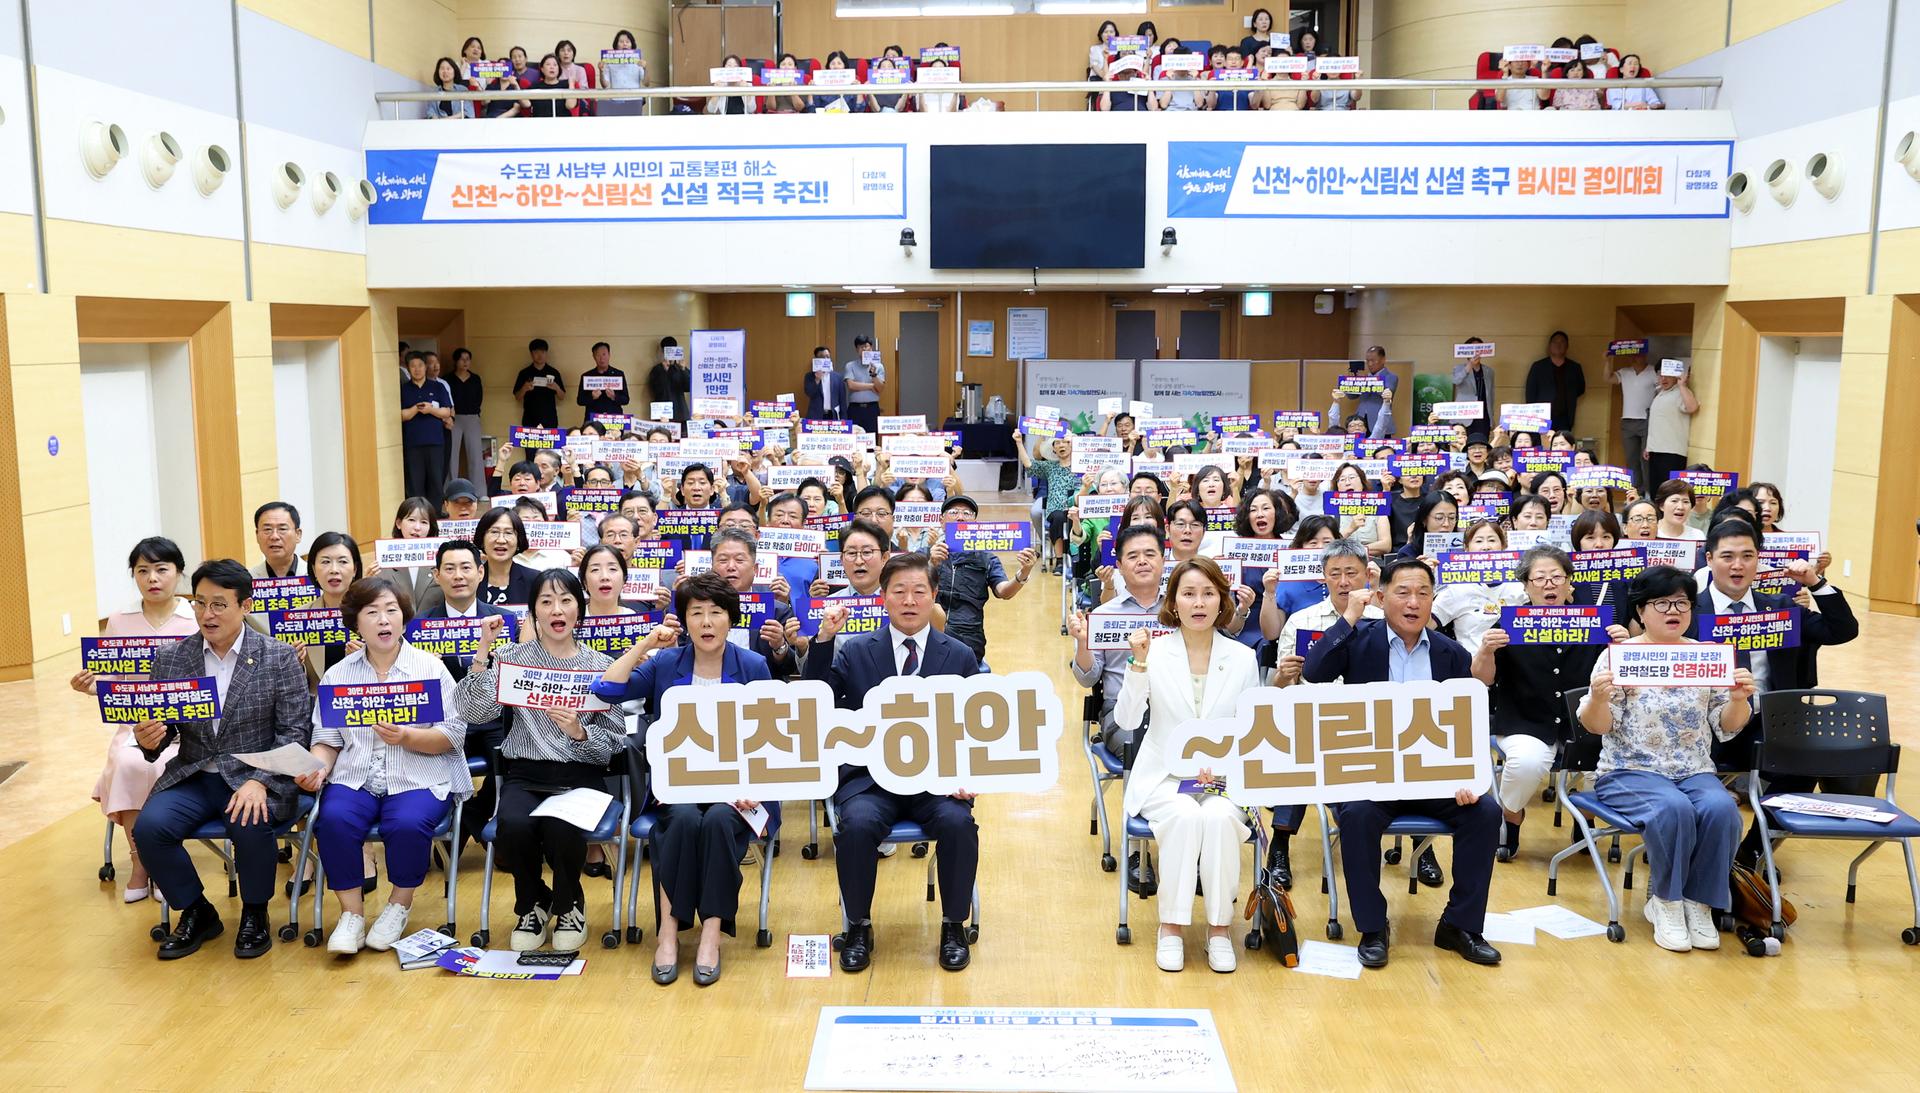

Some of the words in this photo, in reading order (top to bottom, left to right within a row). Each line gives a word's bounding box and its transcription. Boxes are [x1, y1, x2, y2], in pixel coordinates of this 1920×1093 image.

[501, 162, 551, 180] 수도권
[557, 162, 607, 180] 서남부
[613, 161, 663, 178] 시민의
[669, 161, 737, 178] 교통불편
[745, 160, 777, 177] 해소
[1686, 168, 1711, 178] 다함께
[1252, 165, 1418, 195] 신천~하안~신림선
[1426, 164, 1465, 194] 신설
[1472, 164, 1510, 194] 촉구
[1517, 164, 1577, 194] 범시민
[1584, 164, 1662, 194] 결의대회
[1686, 180, 1719, 190] 광명해요
[863, 182, 894, 192] 광명해요
[450, 183, 652, 209] 신천~하안~신림선
[662, 183, 708, 208] 신설
[718, 182, 765, 207] 적극
[774, 181, 828, 206] 추진!
[703, 372, 732, 383] 범시민
[705, 385, 729, 396] 1만명
[520, 440, 554, 450] 신설하라!
[833, 442, 854, 452] 답이다!
[605, 453, 635, 462] 신설하라!
[920, 465, 946, 475] 연결하라!
[1401, 467, 1437, 476] 반영하라!
[1526, 463, 1562, 472] 반영하라!
[566, 495, 584, 504] 수도권
[585, 496, 602, 504] 서남부
[1329, 498, 1362, 507] 국가철도망
[1363, 498, 1387, 507] 구축계획
[566, 502, 593, 512] 민자사업
[594, 503, 609, 512] 조속
[1083, 505, 1111, 515] 광역철도망
[1339, 506, 1378, 516] 반영하라!
[441, 520, 455, 529] 30만
[455, 520, 471, 529] 시민의
[533, 523, 549, 531] 시민의
[550, 523, 565, 531] 염원!
[658, 517, 678, 526] 수도권
[680, 517, 699, 526] 서남부
[658, 524, 688, 536] 민자사업
[690, 525, 706, 536] 조속
[954, 530, 1022, 540] 신천~하안~신림선
[387, 543, 406, 552] 출퇴근
[407, 542, 433, 551] 교통지옥
[963, 539, 1014, 552] 신설하라!
[381, 553, 403, 564] 철도망
[404, 552, 425, 563] 확충이
[1291, 555, 1310, 563] 출퇴근
[1453, 553, 1471, 561] 수도권
[635, 573, 650, 582] 보장!
[1442, 571, 1480, 583] 민자사업
[1483, 570, 1503, 582] 조속
[253, 588, 278, 599] 서남부
[280, 585, 316, 597] 광역철도
[288, 612, 308, 621] 수도권
[309, 611, 328, 620] 서남부
[1529, 608, 1545, 616] 30만
[1546, 608, 1565, 616] 시민의
[275, 621, 304, 632] 수도권
[306, 619, 333, 631] 서남부
[425, 619, 445, 628] 수도권
[446, 618, 465, 627] 서남부
[1103, 620, 1127, 630] 출퇴근
[1129, 619, 1160, 630] 교통지옥
[1512, 616, 1602, 629] 신천~하안~신림선
[412, 629, 441, 641] 수도권
[443, 628, 471, 640] 서남부
[1712, 621, 1793, 638] 신천~하안~신림선
[1094, 631, 1121, 643] 철도망
[1523, 629, 1589, 644] 신설하라!
[610, 638, 632, 652] 조속
[87, 648, 118, 660] 수도권
[121, 648, 151, 660] 서남부
[1622, 652, 1668, 663] 광명시민의
[1670, 651, 1698, 663] 교통권
[1701, 651, 1722, 662] 보장!
[523, 669, 543, 679] 30만
[545, 671, 571, 682] 시민의
[574, 673, 593, 683] 염원!
[1618, 665, 1669, 679] 광역철도망
[1673, 663, 1727, 680] 연결하라!
[114, 682, 135, 692] 수도권
[137, 682, 158, 692] 서남부
[160, 681, 193, 692] 교통혁명,
[103, 693, 132, 706] 수도권
[134, 692, 164, 705] 서남부
[167, 690, 213, 705] 광역철도
[332, 693, 429, 710] 신천~하안~신림선
[526, 693, 586, 709] 신설하라!
[104, 706, 150, 723] 민자사업
[153, 705, 179, 721] 조속
[182, 703, 215, 719] 추진!
[344, 708, 417, 726] 신설하라!
[663, 690, 1044, 785] 신천~하안
[1183, 695, 1474, 788] ~신림선
